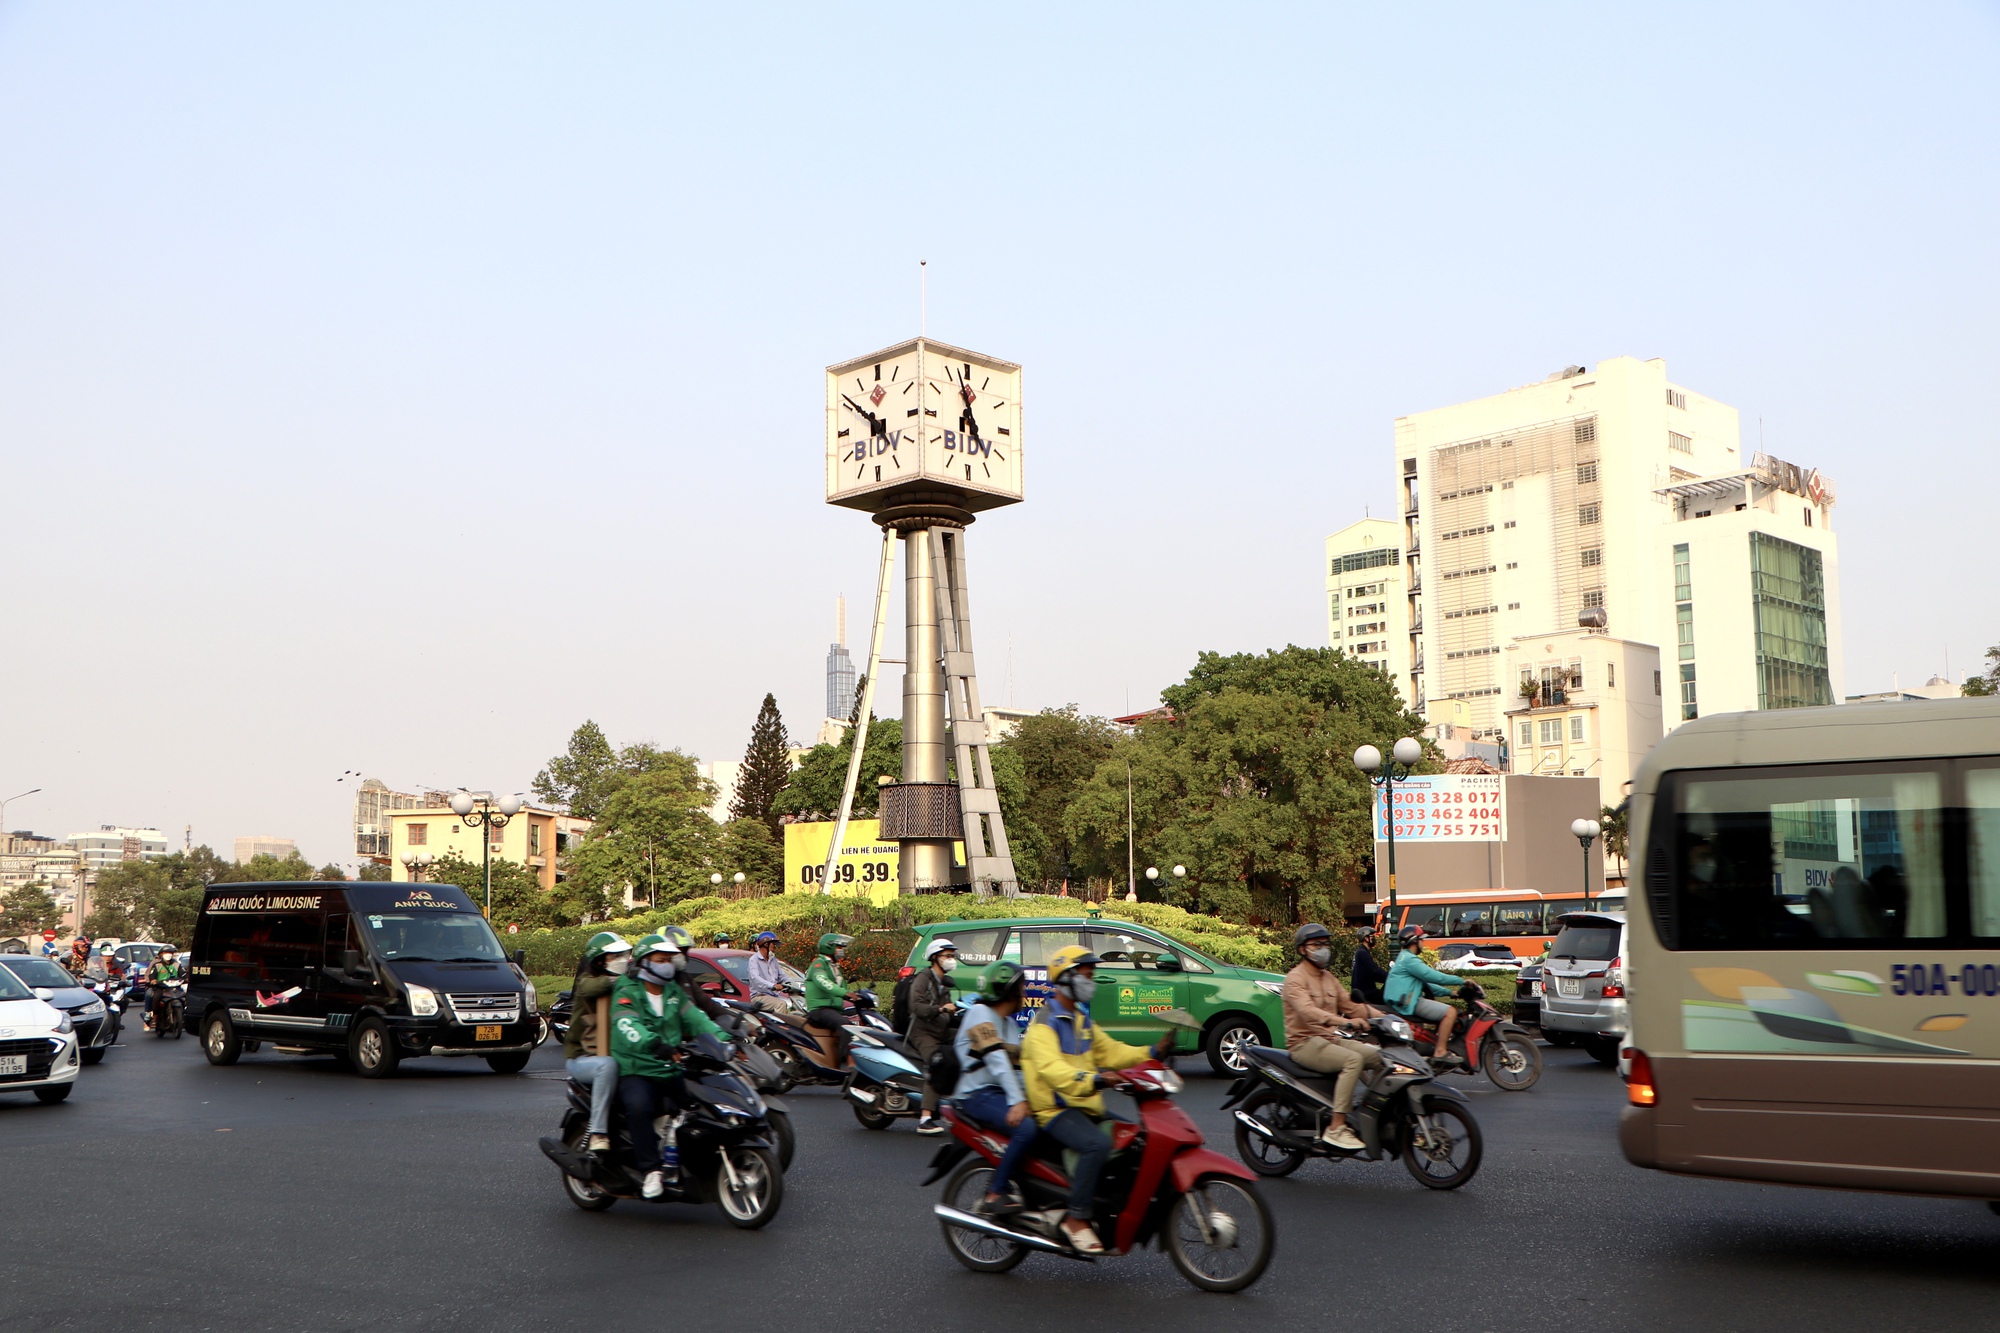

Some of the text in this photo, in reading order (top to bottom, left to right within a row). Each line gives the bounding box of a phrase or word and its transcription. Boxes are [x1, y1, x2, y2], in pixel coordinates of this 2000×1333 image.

[854, 430, 903, 461] BIDV
[944, 430, 993, 459] BIDV
[1768, 455, 1809, 497] BIDV
[1382, 791, 1500, 804] 0908 328 017
[1382, 807, 1500, 820] 0933 462 404
[1383, 824, 1499, 836] 0977 755 751
[1805, 869, 1828, 887] BIDV
[219, 897, 239, 910] ANH
[265, 896, 321, 909] LIMOUSINE
[394, 900, 421, 908] ANH
